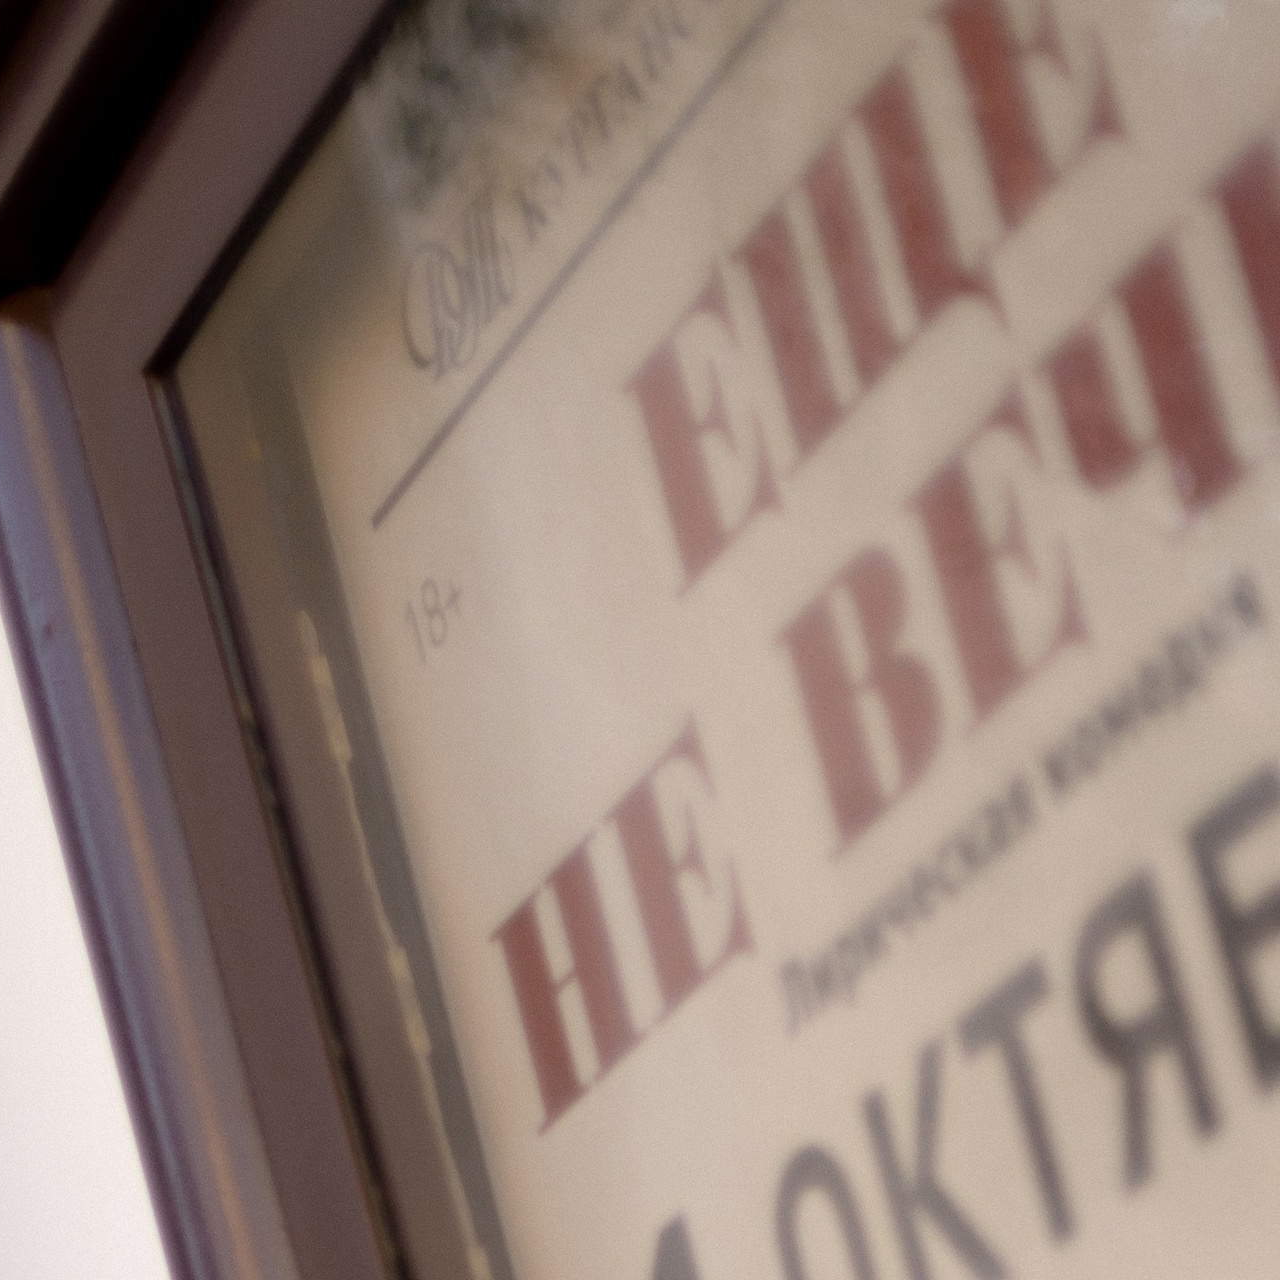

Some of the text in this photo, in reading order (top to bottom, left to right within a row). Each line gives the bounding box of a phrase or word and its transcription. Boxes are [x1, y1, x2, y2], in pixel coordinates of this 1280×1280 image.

[403, 578, 462, 664] 18+
[488, 122, 1280, 1138] НЕ ВЕЧ
